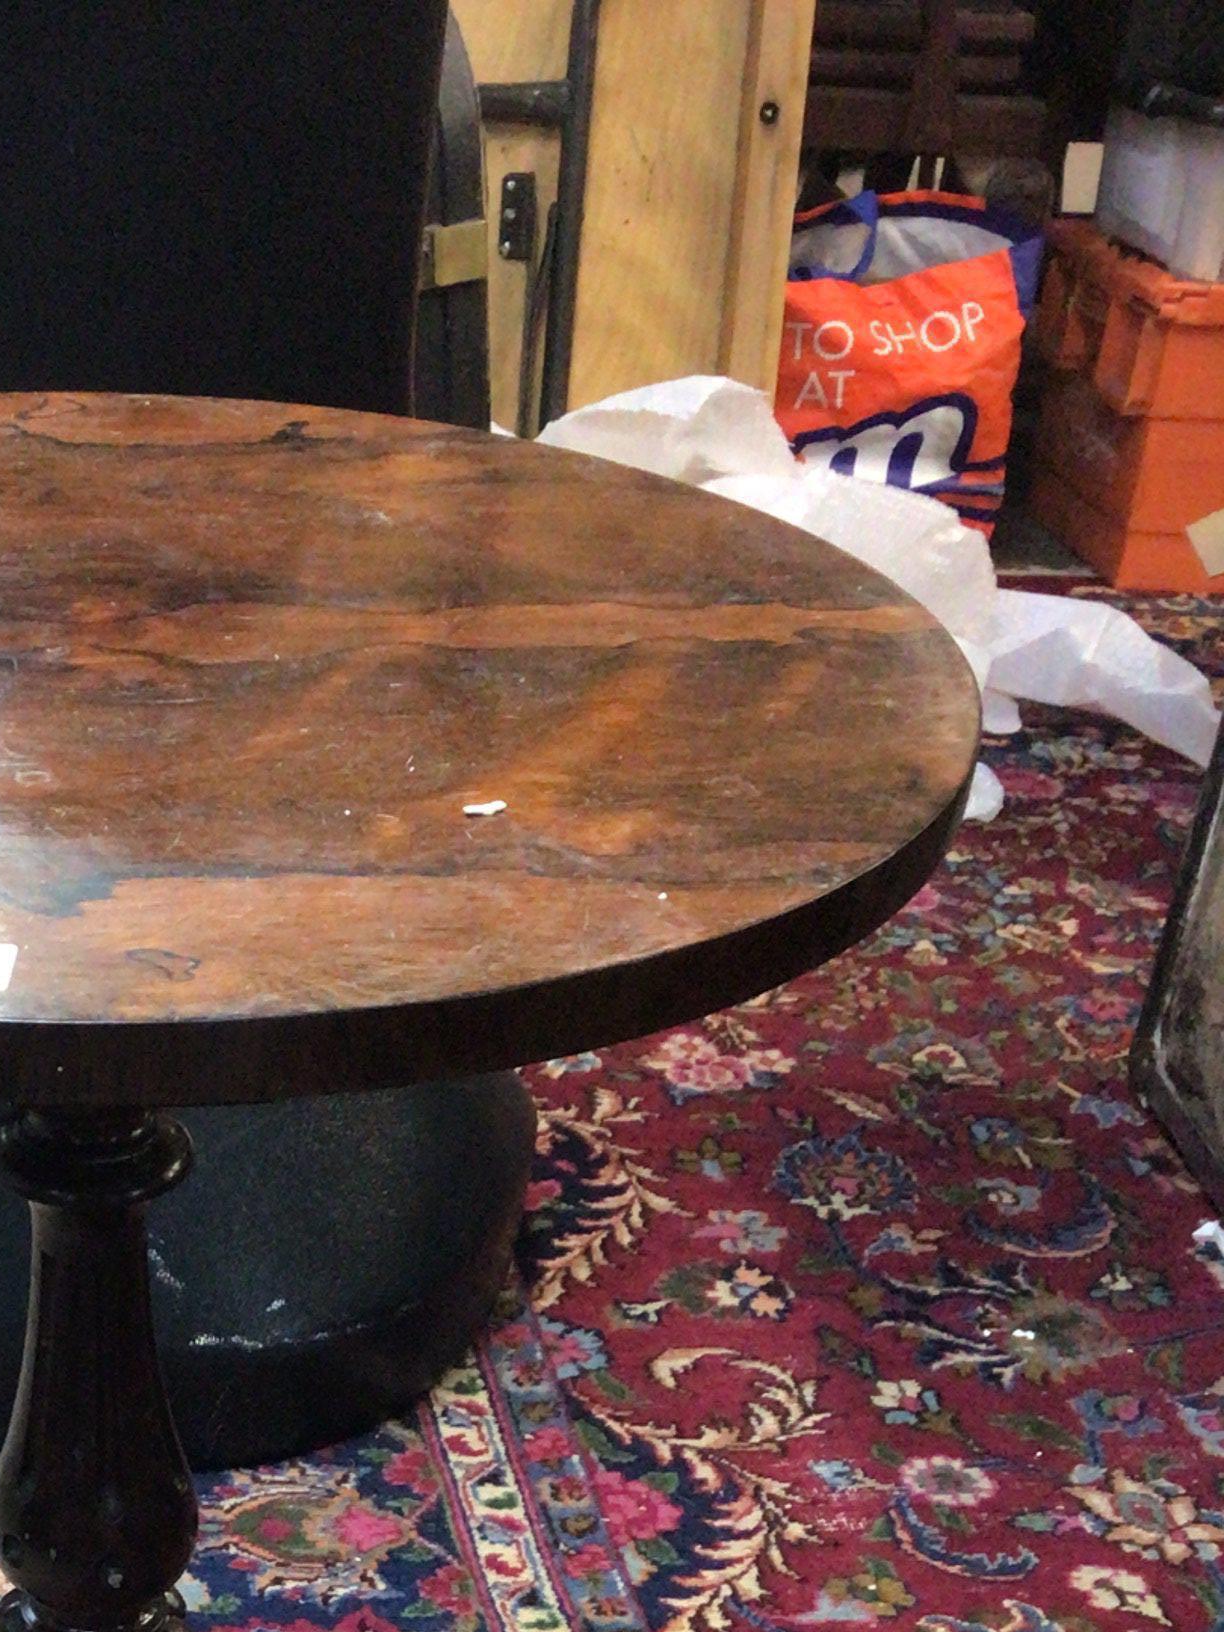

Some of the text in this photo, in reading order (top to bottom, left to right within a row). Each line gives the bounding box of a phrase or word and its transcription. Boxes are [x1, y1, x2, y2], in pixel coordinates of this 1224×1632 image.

[786, 301, 985, 361] TO SHOP
[793, 369, 856, 410] AT
